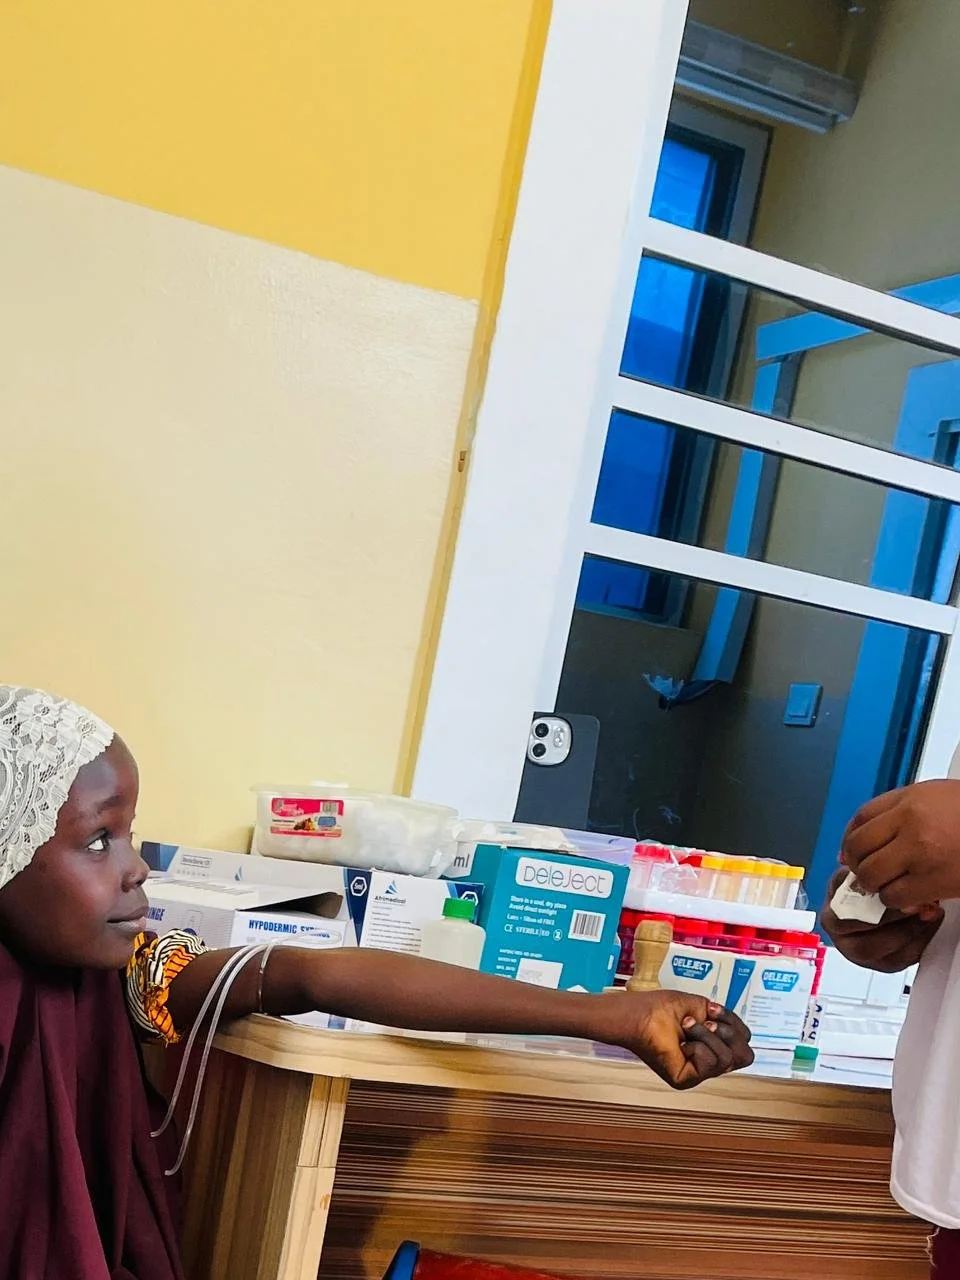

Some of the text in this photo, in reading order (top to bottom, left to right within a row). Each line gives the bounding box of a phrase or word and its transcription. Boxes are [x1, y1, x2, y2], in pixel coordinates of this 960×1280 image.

[147, 907, 165, 921] INGE
[248, 919, 298, 934] HYPODERMIC
[673, 956, 711, 972] DELEJECT
[763, 971, 798, 983] DELEJECT
